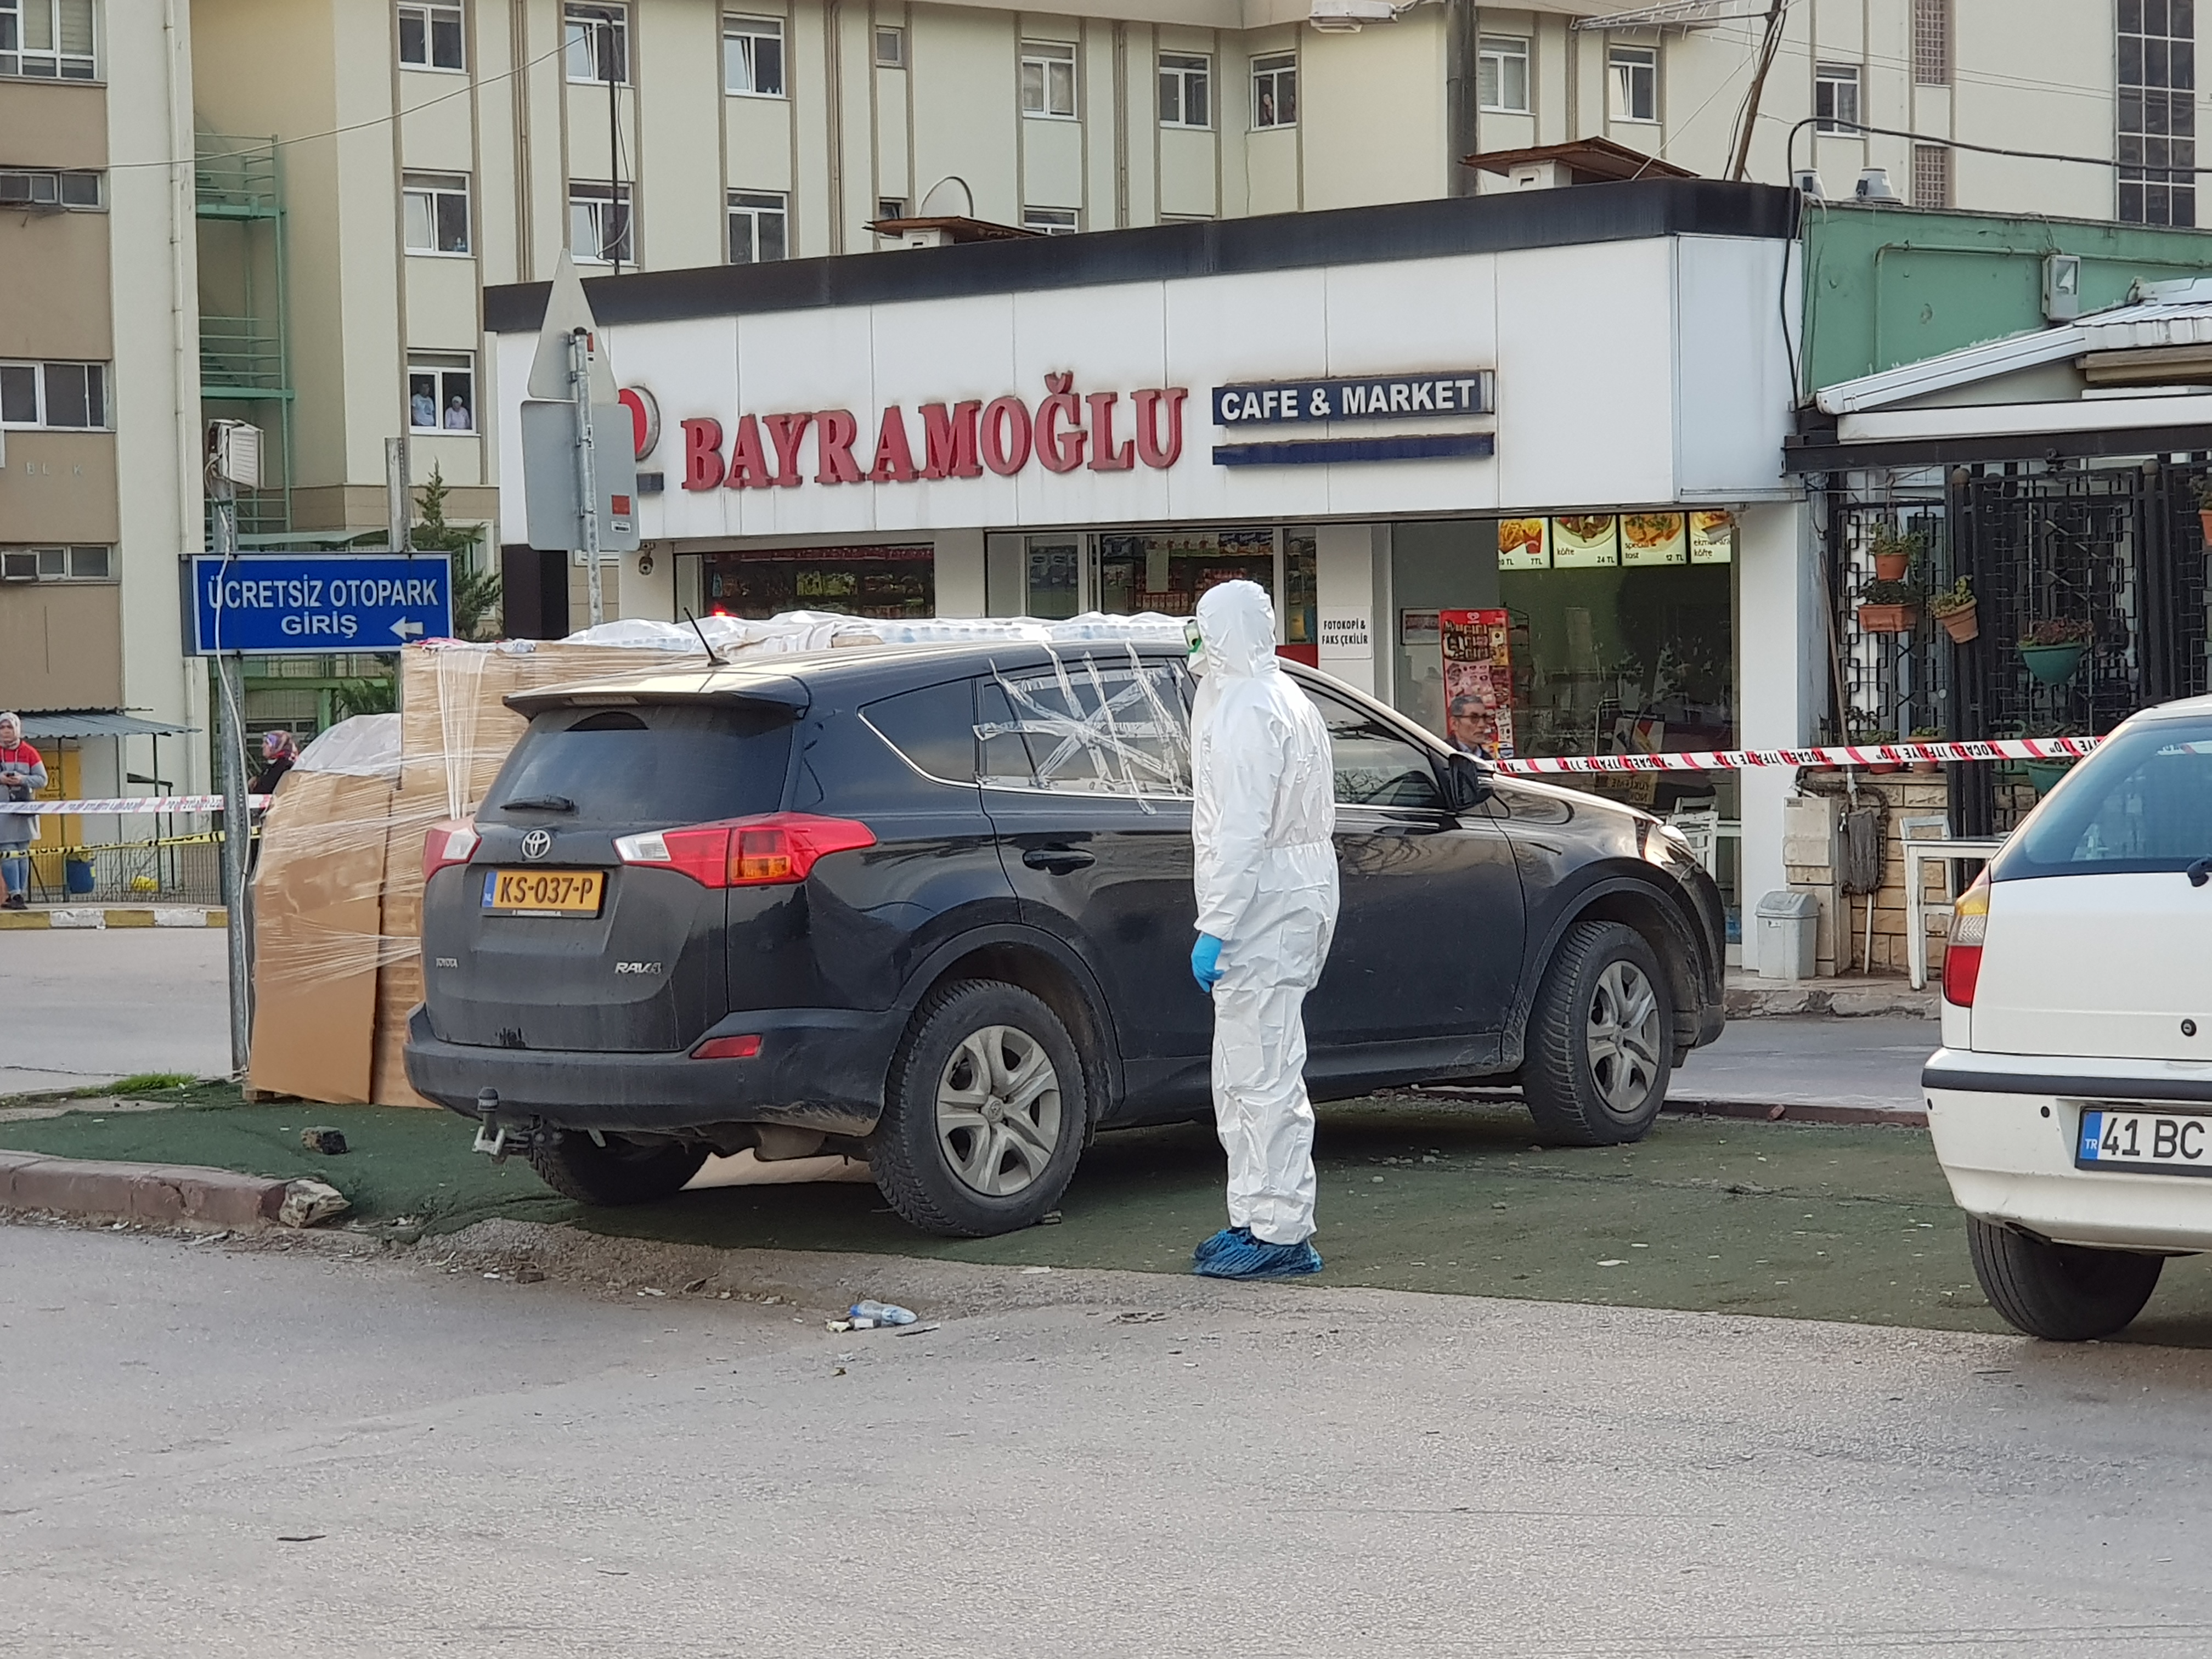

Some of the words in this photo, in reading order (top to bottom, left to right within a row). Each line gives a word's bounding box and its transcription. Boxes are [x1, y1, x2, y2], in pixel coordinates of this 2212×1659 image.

[1221, 390, 1299, 421] CAFE
[1309, 388, 1331, 416] &
[1342, 379, 1475, 415] MARKET
[681, 370, 1188, 491] BAYRAMOĞLU
[1556, 548, 1575, 556] köfte
[208, 574, 323, 608] ÜCRETSİZ
[329, 579, 439, 607] OTOPARK
[280, 611, 358, 639] GİRİŞ
[1323, 618, 1359, 630] FOTOKOPİ
[1360, 620, 1366, 629] &
[1322, 635, 1339, 645] FAKS
[1340, 633, 1368, 647] ÇEKİLİR
[500, 876, 593, 905] KS-037-P
[436, 958, 459, 968] TOYOTA
[614, 962, 662, 974] RAV4
[2084, 1138, 2098, 1150] TR
[2102, 1117, 2140, 1156] 41
[2153, 1119, 2205, 1160] BC
